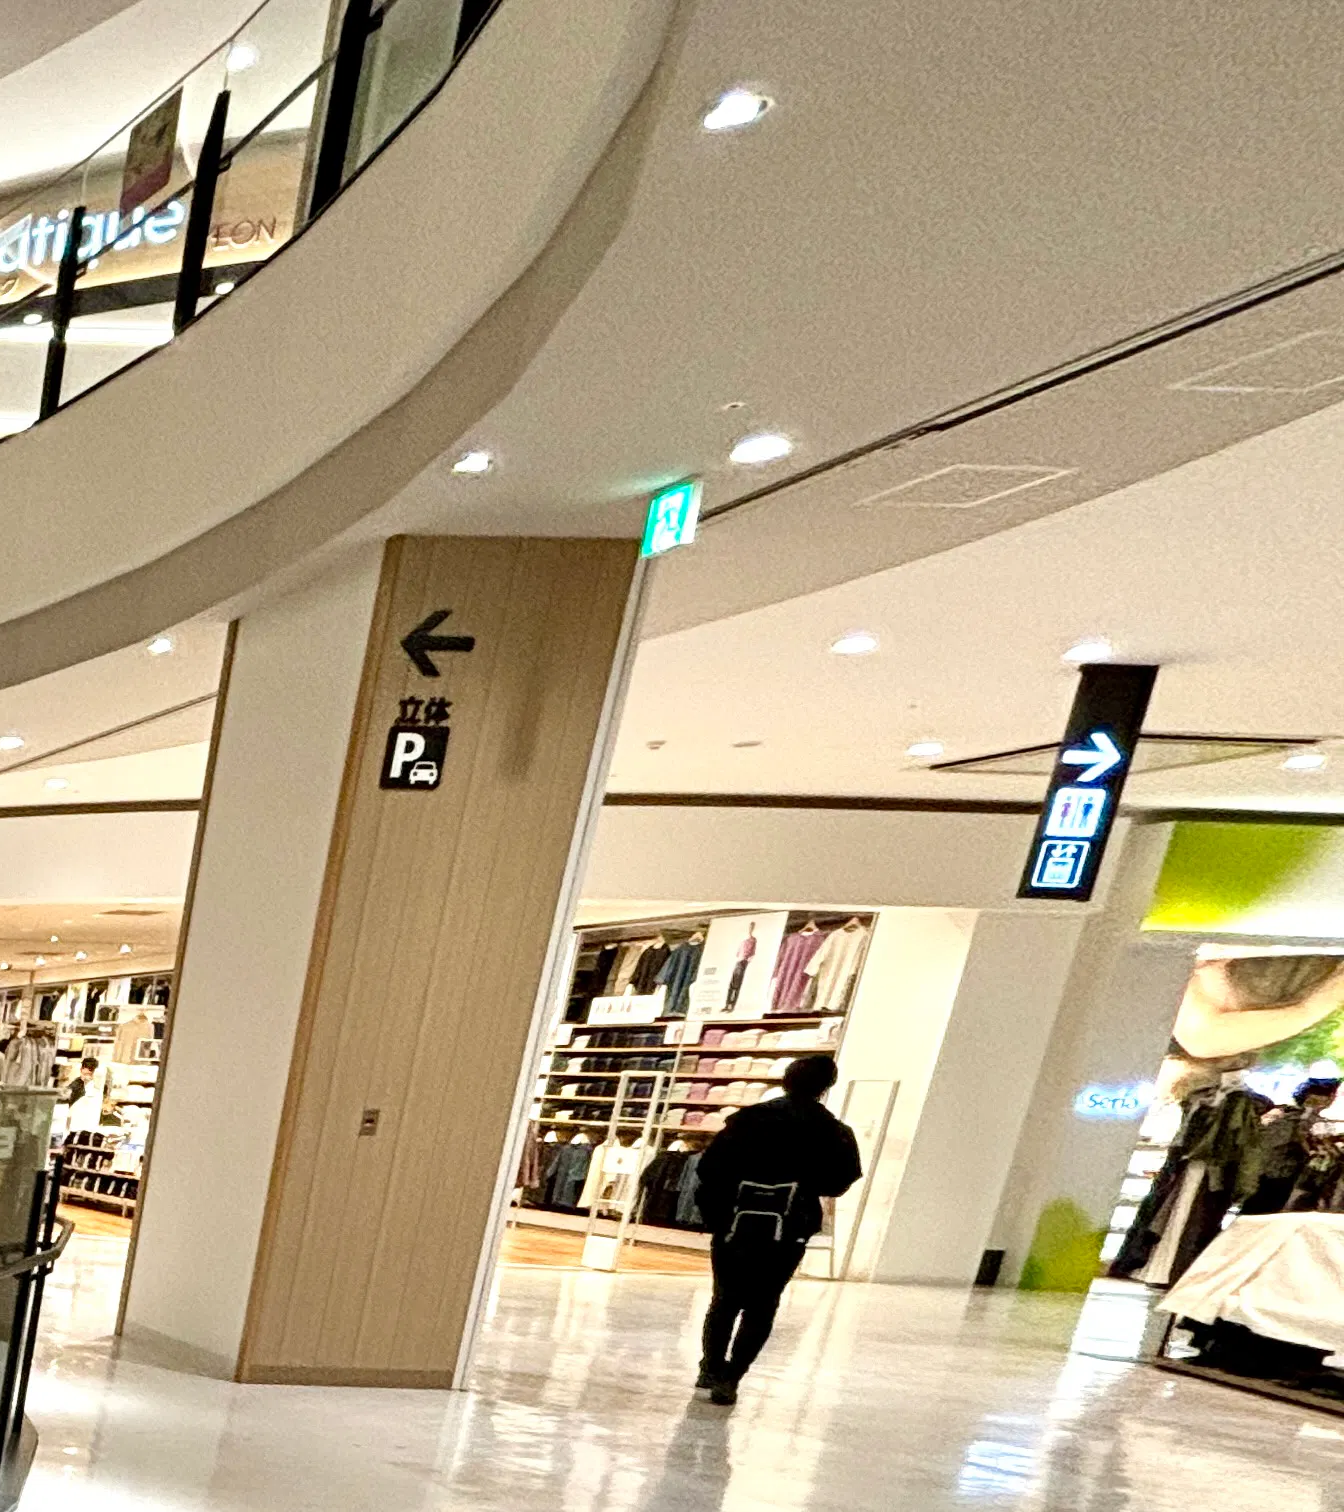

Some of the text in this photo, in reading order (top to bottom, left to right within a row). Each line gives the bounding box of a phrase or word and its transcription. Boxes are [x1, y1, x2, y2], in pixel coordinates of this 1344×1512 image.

[212, 217, 277, 250] EON
[394, 695, 453, 724] 立体
[389, 731, 426, 779] P
